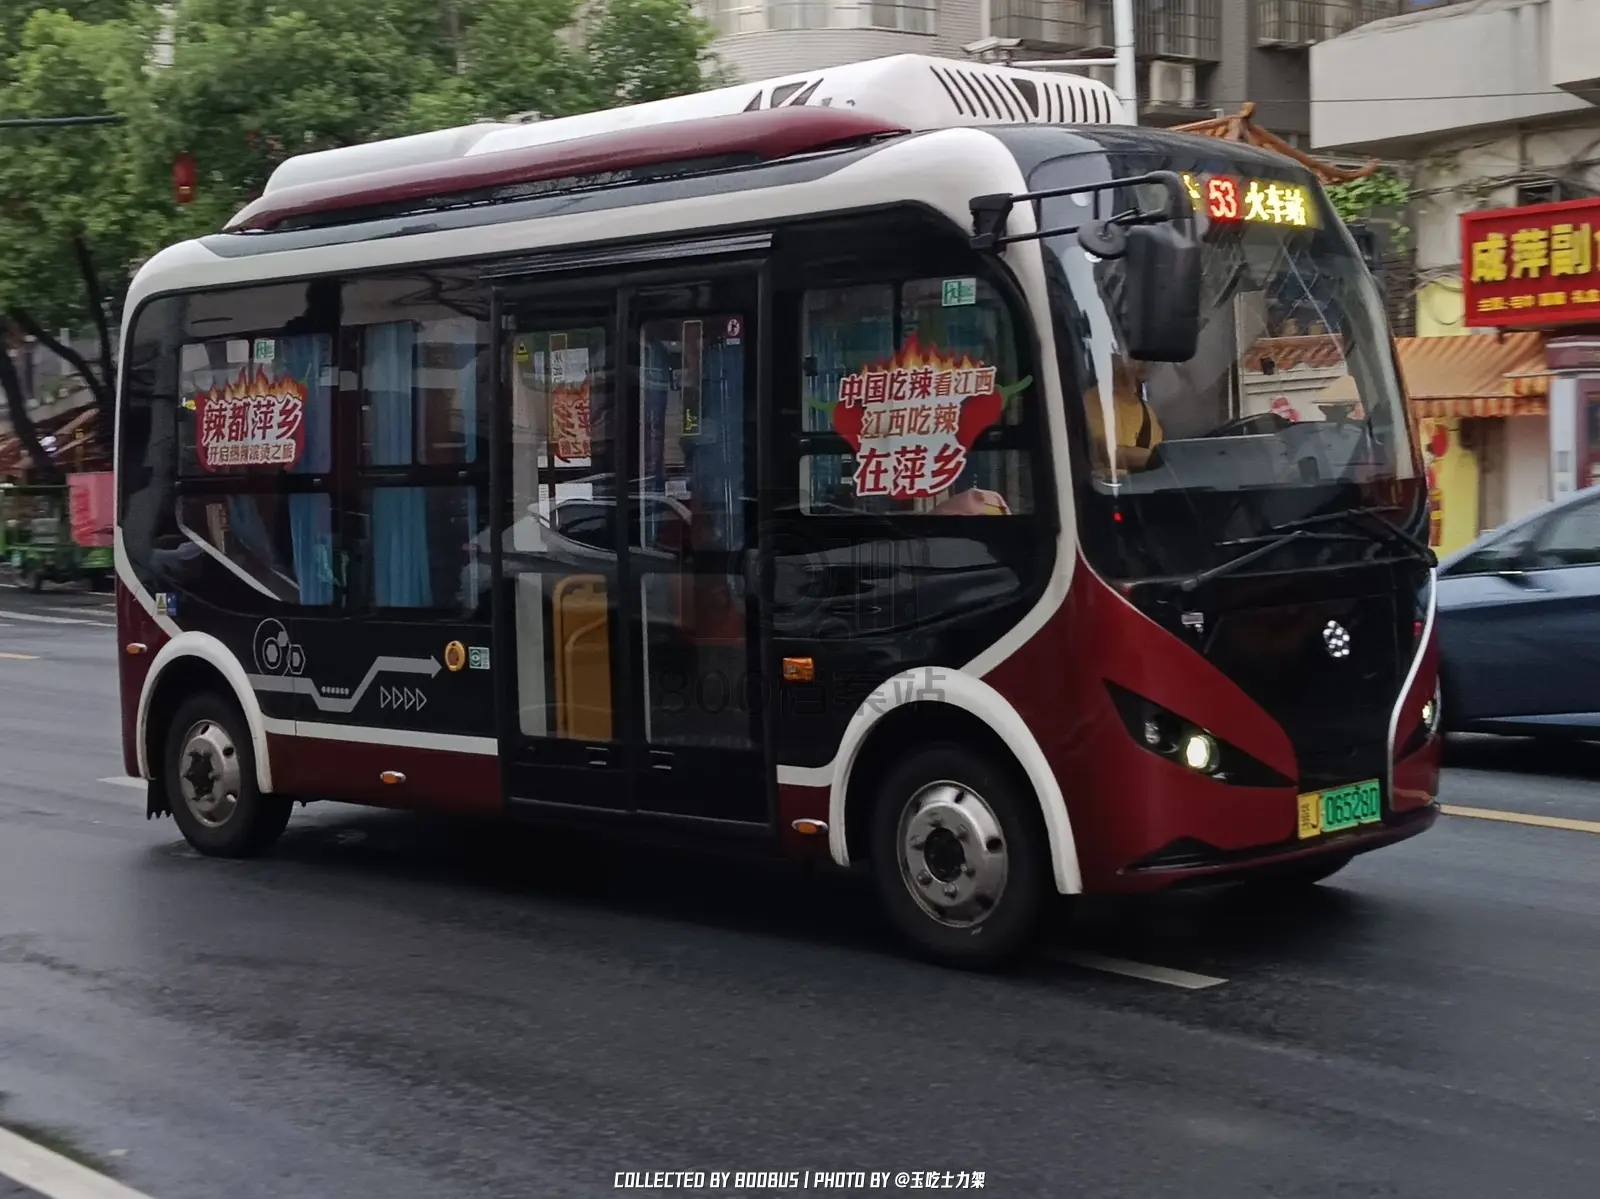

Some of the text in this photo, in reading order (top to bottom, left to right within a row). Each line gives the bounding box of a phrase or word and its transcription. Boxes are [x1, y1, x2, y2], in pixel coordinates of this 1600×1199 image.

[1208, 179, 1237, 218] 53
[1244, 181, 1306, 226] 火车站
[1471, 223, 1600, 283] 成萍副
[841, 367, 995, 405] 中国吃辣看江西
[203, 397, 302, 444] 辣都萍乡
[861, 403, 959, 439] 江西吃辣
[856, 444, 965, 494] 在萍乡
